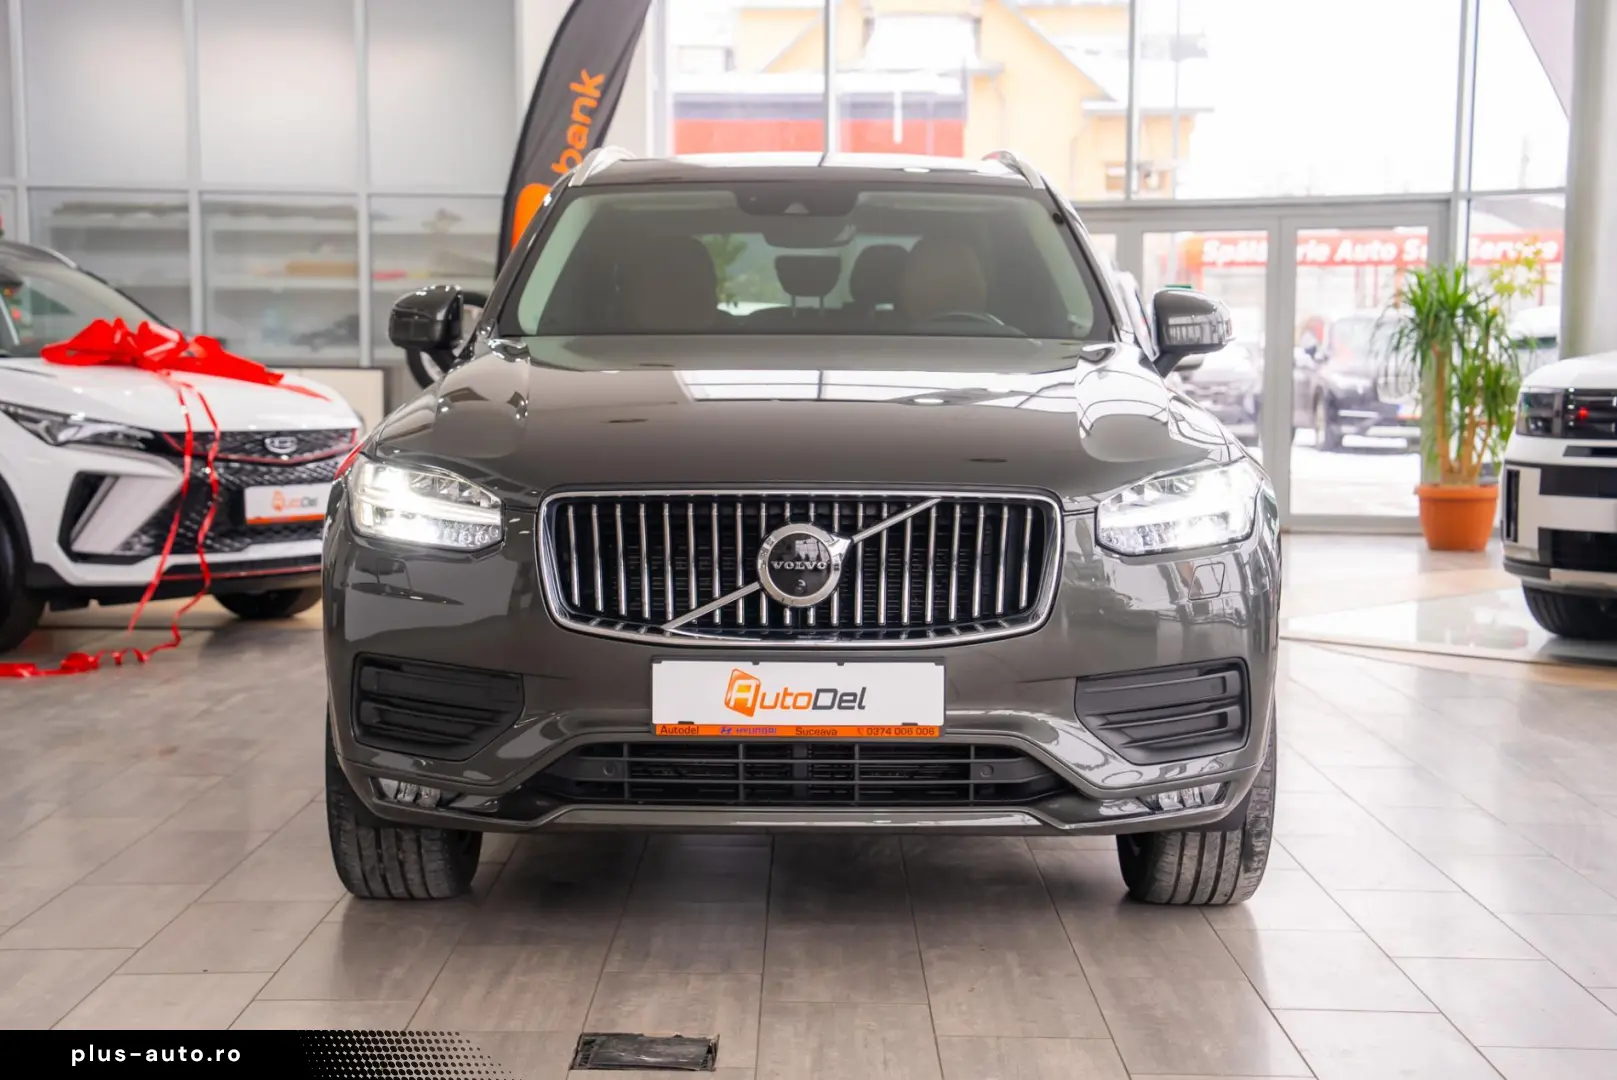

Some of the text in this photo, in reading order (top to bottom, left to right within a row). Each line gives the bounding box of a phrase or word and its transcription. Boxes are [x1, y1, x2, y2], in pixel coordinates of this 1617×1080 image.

[552, 69, 606, 175] bank
[1333, 239, 1397, 262] Auto
[770, 560, 828, 570] VOLVO
[725, 674, 867, 714] AutoDel
[660, 725, 699, 736] Autodel
[795, 726, 838, 737] Suceava
